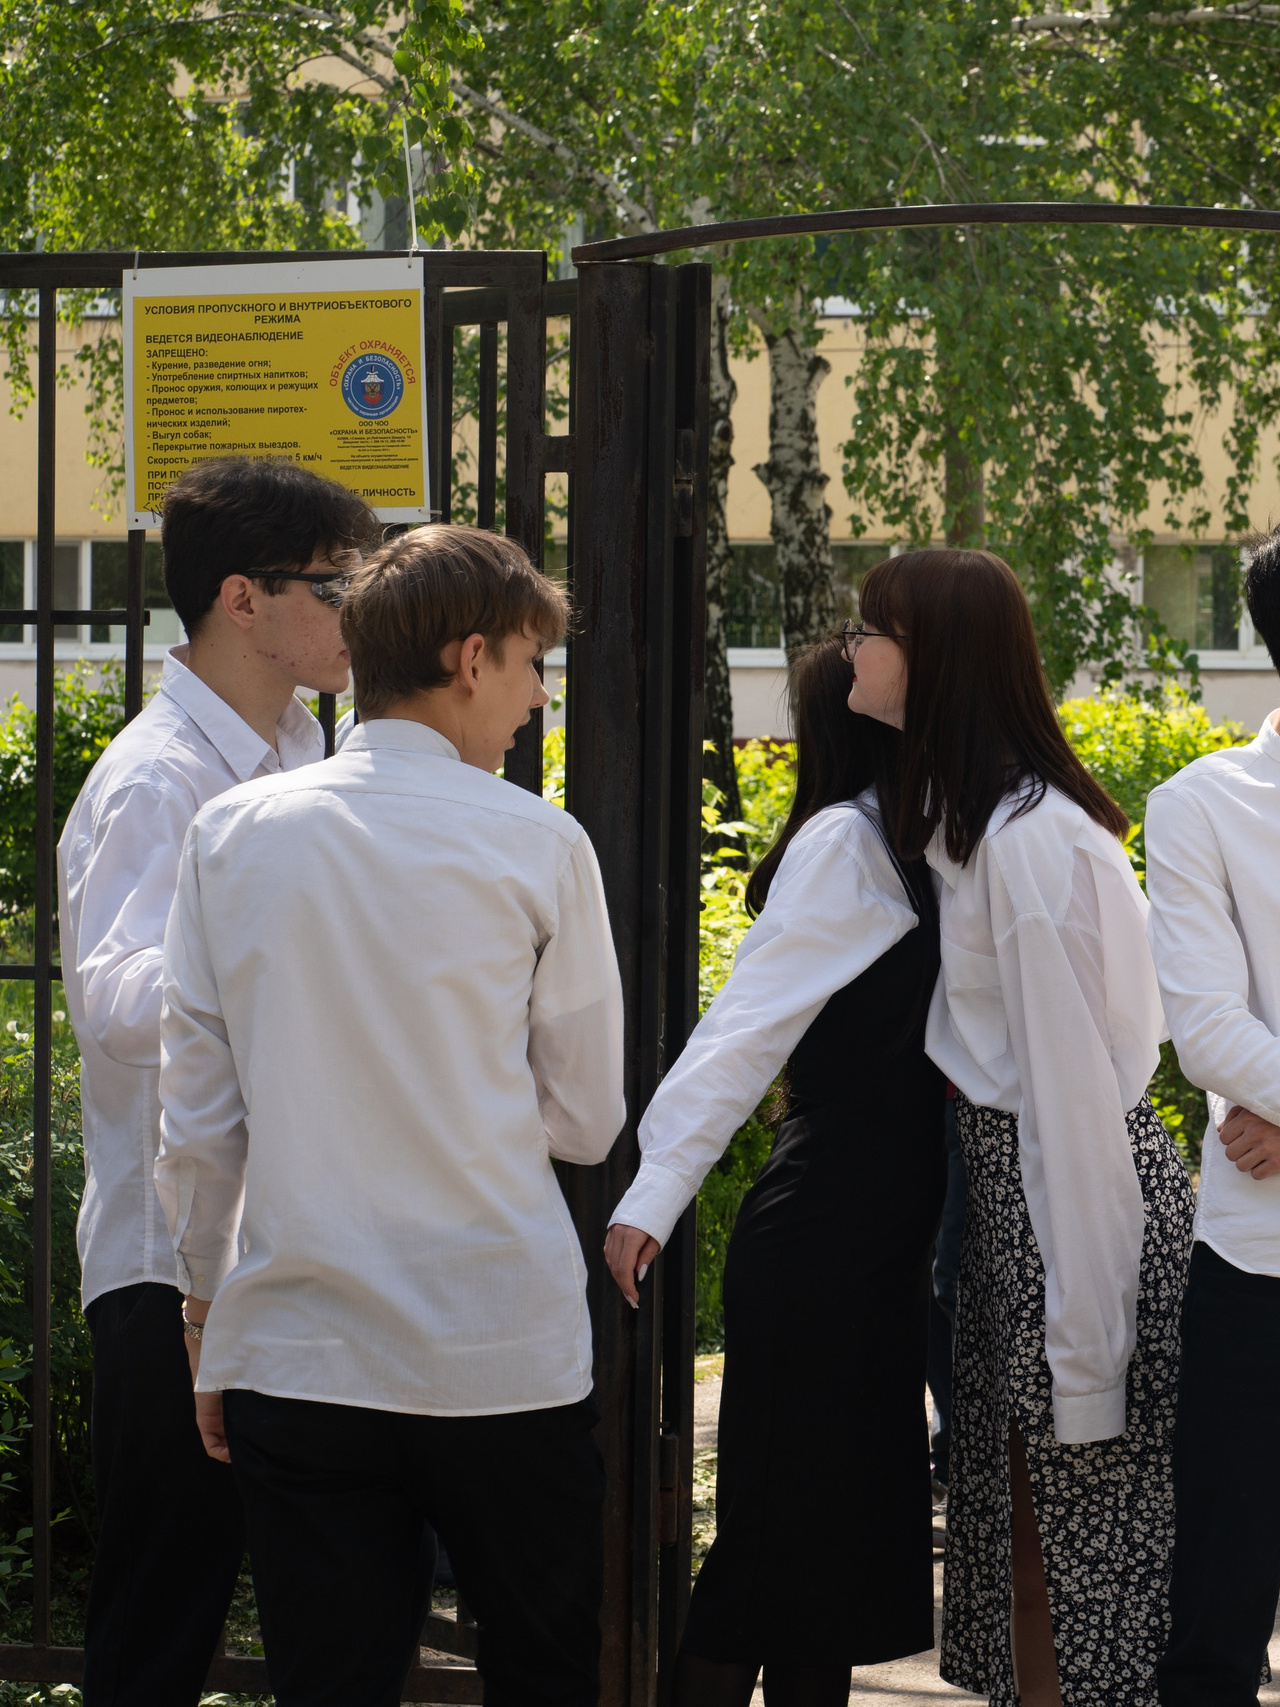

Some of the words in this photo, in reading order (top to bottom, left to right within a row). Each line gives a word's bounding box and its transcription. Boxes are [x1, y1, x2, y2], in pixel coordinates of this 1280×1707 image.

[145, 305, 195, 315] УСЛОВИЯ
[198, 303, 276, 313] ПРОПУСКНОГО
[279, 302, 287, 311] И
[290, 299, 412, 311] ВНУТРИОБЪЕКТОВОГО
[254, 314, 301, 324] РЕЖИМА
[146, 334, 192, 343] ВЕДЕТСЯ
[195, 331, 303, 342] ВИДЕОНАБЛЮДЕНИЕ
[146, 348, 208, 358] ЗАПРЕЩЕНО:
[152, 360, 191, 371] Курение,
[193, 360, 246, 369] разведение
[248, 359, 271, 368] огня;
[330, 345, 357, 386] ОБЪЕКТ
[360, 340, 416, 384] ОХРАНЯЕТСЯ
[152, 372, 214, 382] Употребление
[217, 372, 260, 381] спиртных
[264, 370, 308, 379] напитков;
[152, 384, 185, 393] Пронос
[188, 384, 223, 394] оружия,
[225, 383, 267, 392] колющих
[278, 382, 318, 391] режущих
[146, 396, 198, 406] предметов;
[152, 407, 185, 416] Пронос
[196, 406, 264, 416] использование
[267, 405, 307, 415] пиротех-
[147, 419, 187, 428] нических
[190, 418, 231, 427] изделий;
[153, 431, 182, 440] Выгул
[184, 430, 212, 439] собак;
[153, 442, 206, 452] Перекрытие
[209, 441, 256, 451] пожарных
[259, 440, 301, 450] выездов.
[147, 456, 189, 465] Скорость
[303, 453, 322, 461] км/ч
[148, 471, 166, 479] ПРИ
[363, 487, 415, 497] ЛИЧНОСТЬ
